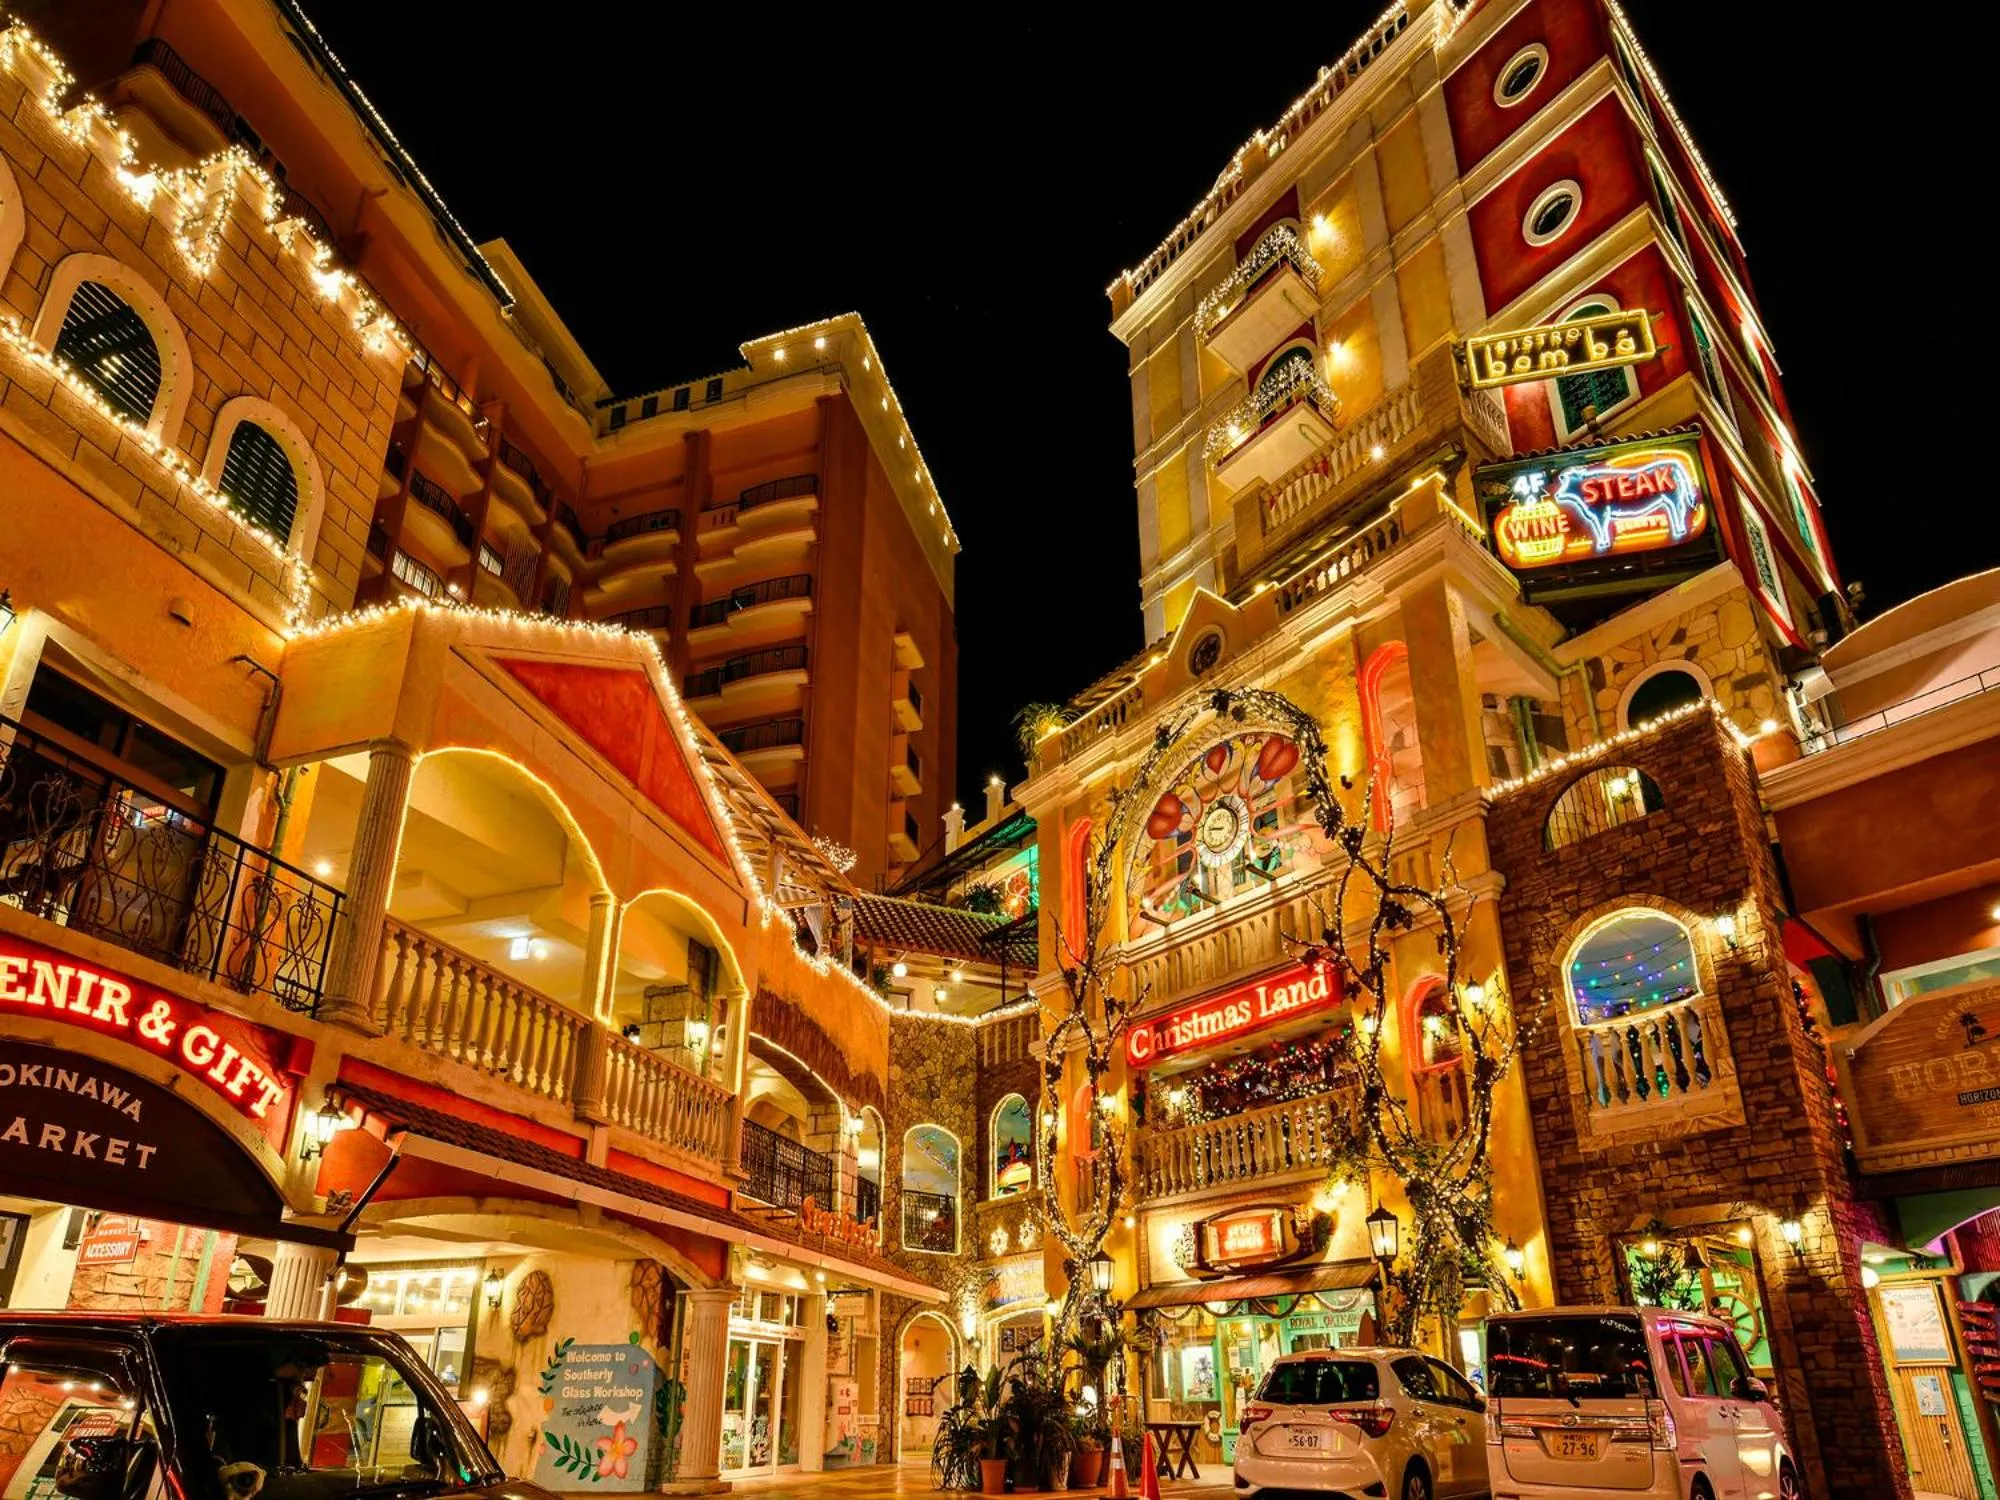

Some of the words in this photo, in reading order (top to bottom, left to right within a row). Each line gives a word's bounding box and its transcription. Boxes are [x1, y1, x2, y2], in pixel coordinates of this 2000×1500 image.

[1494, 328, 1581, 355] BISTRO
[1512, 472, 1546, 496] 4F
[1580, 463, 1676, 503] STEAK
[1508, 514, 1571, 540] WINE
[1129, 1000, 1252, 1060] Christmas
[1256, 963, 1330, 1018] Land
[138, 1000, 177, 1046] &
[181, 1025, 285, 1118] GIFT
[0, 1063, 143, 1123] OKINAWA
[566, 1349, 612, 1363] Welcome
[615, 1350, 626, 1362] to
[564, 1367, 614, 1384] Southerly
[562, 1386, 591, 1399] Glass
[593, 1385, 644, 1402] Workshop
[1293, 1435, 1318, 1447] 56-07
[1562, 1442, 1596, 1457] 27-96
